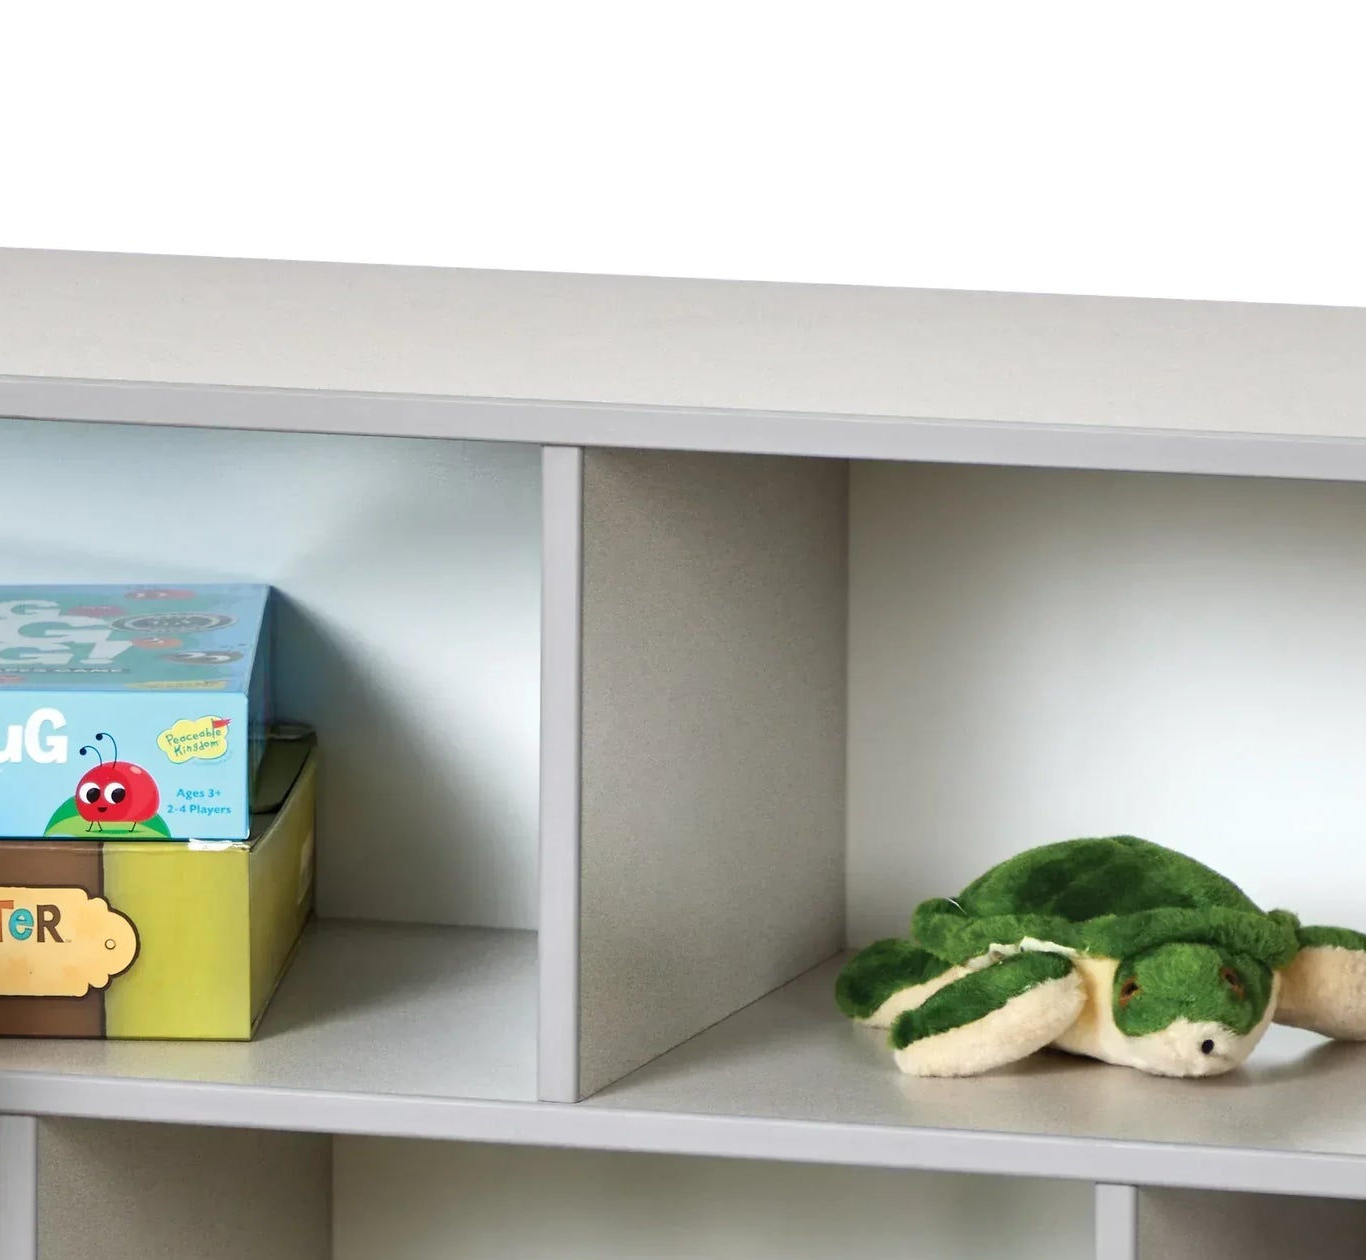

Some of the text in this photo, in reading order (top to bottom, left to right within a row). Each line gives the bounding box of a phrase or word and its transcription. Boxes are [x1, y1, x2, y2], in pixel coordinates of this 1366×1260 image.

[165, 727, 222, 746] Peaceable
[173, 740, 219, 757] Kingdom
[176, 788, 222, 800] Ages 3+
[167, 804, 232, 816] 2-4 Players
